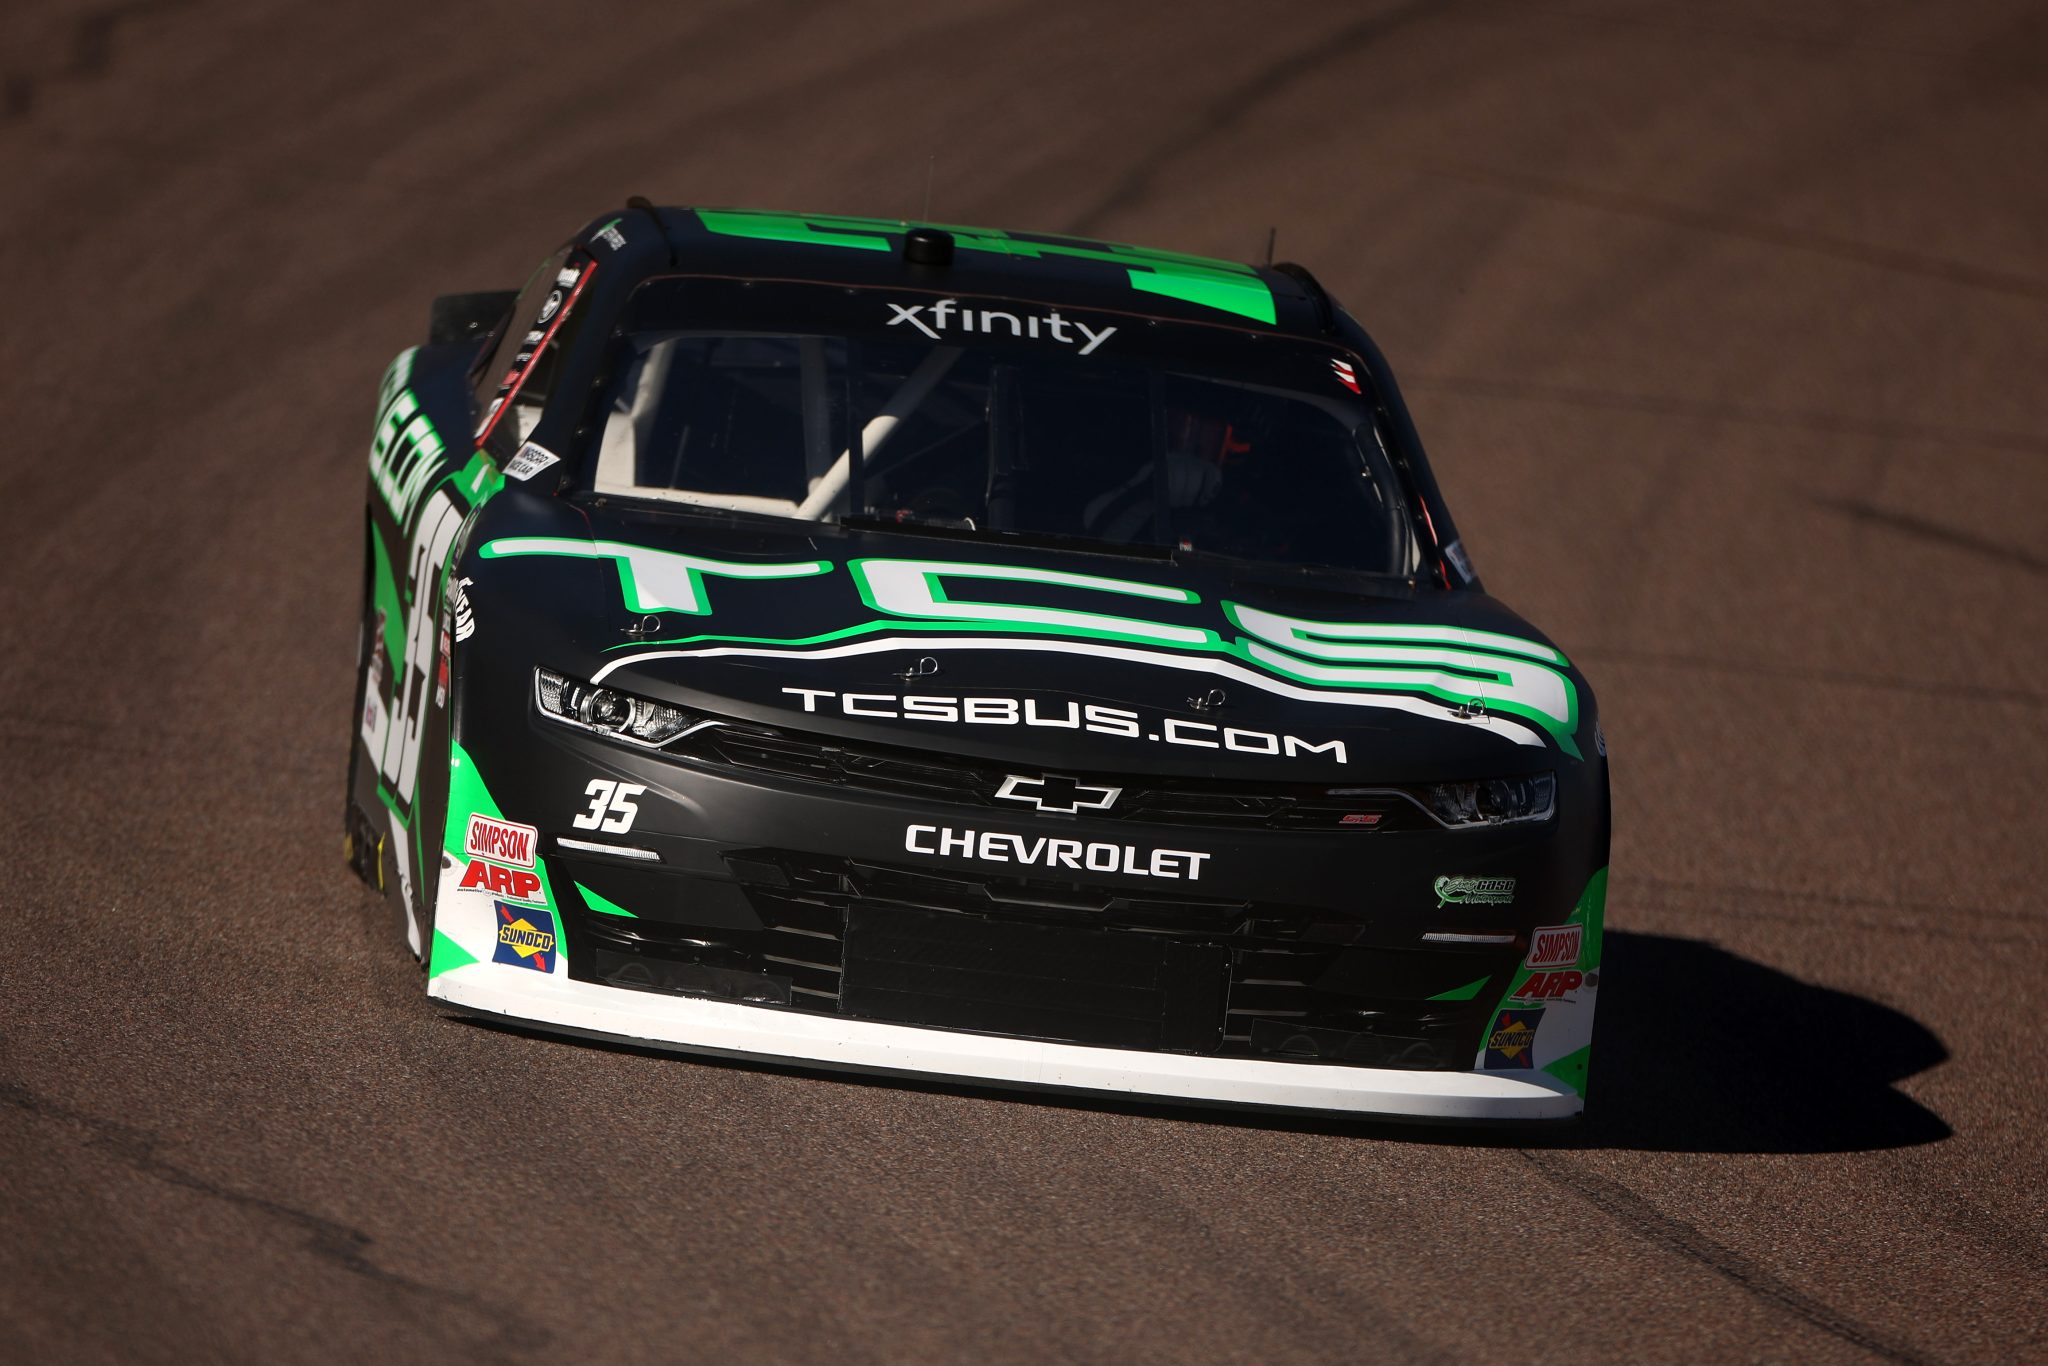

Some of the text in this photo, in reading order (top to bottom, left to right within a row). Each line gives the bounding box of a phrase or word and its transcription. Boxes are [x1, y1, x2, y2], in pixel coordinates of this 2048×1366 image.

[887, 299, 1116, 355] xfinity
[478, 536, 1578, 736] TCS
[781, 687, 1348, 765] TCSBUS.COM
[572, 779, 648, 834] 35
[470, 821, 529, 862] SIMPSON
[905, 824, 1211, 881] CHEVROLET
[459, 859, 541, 898] ARP
[501, 926, 552, 950] SUNOCO
[1532, 931, 1580, 963] SIMPSON
[1512, 971, 1582, 998] ARP
[1491, 1031, 1532, 1048] SUNOCO
